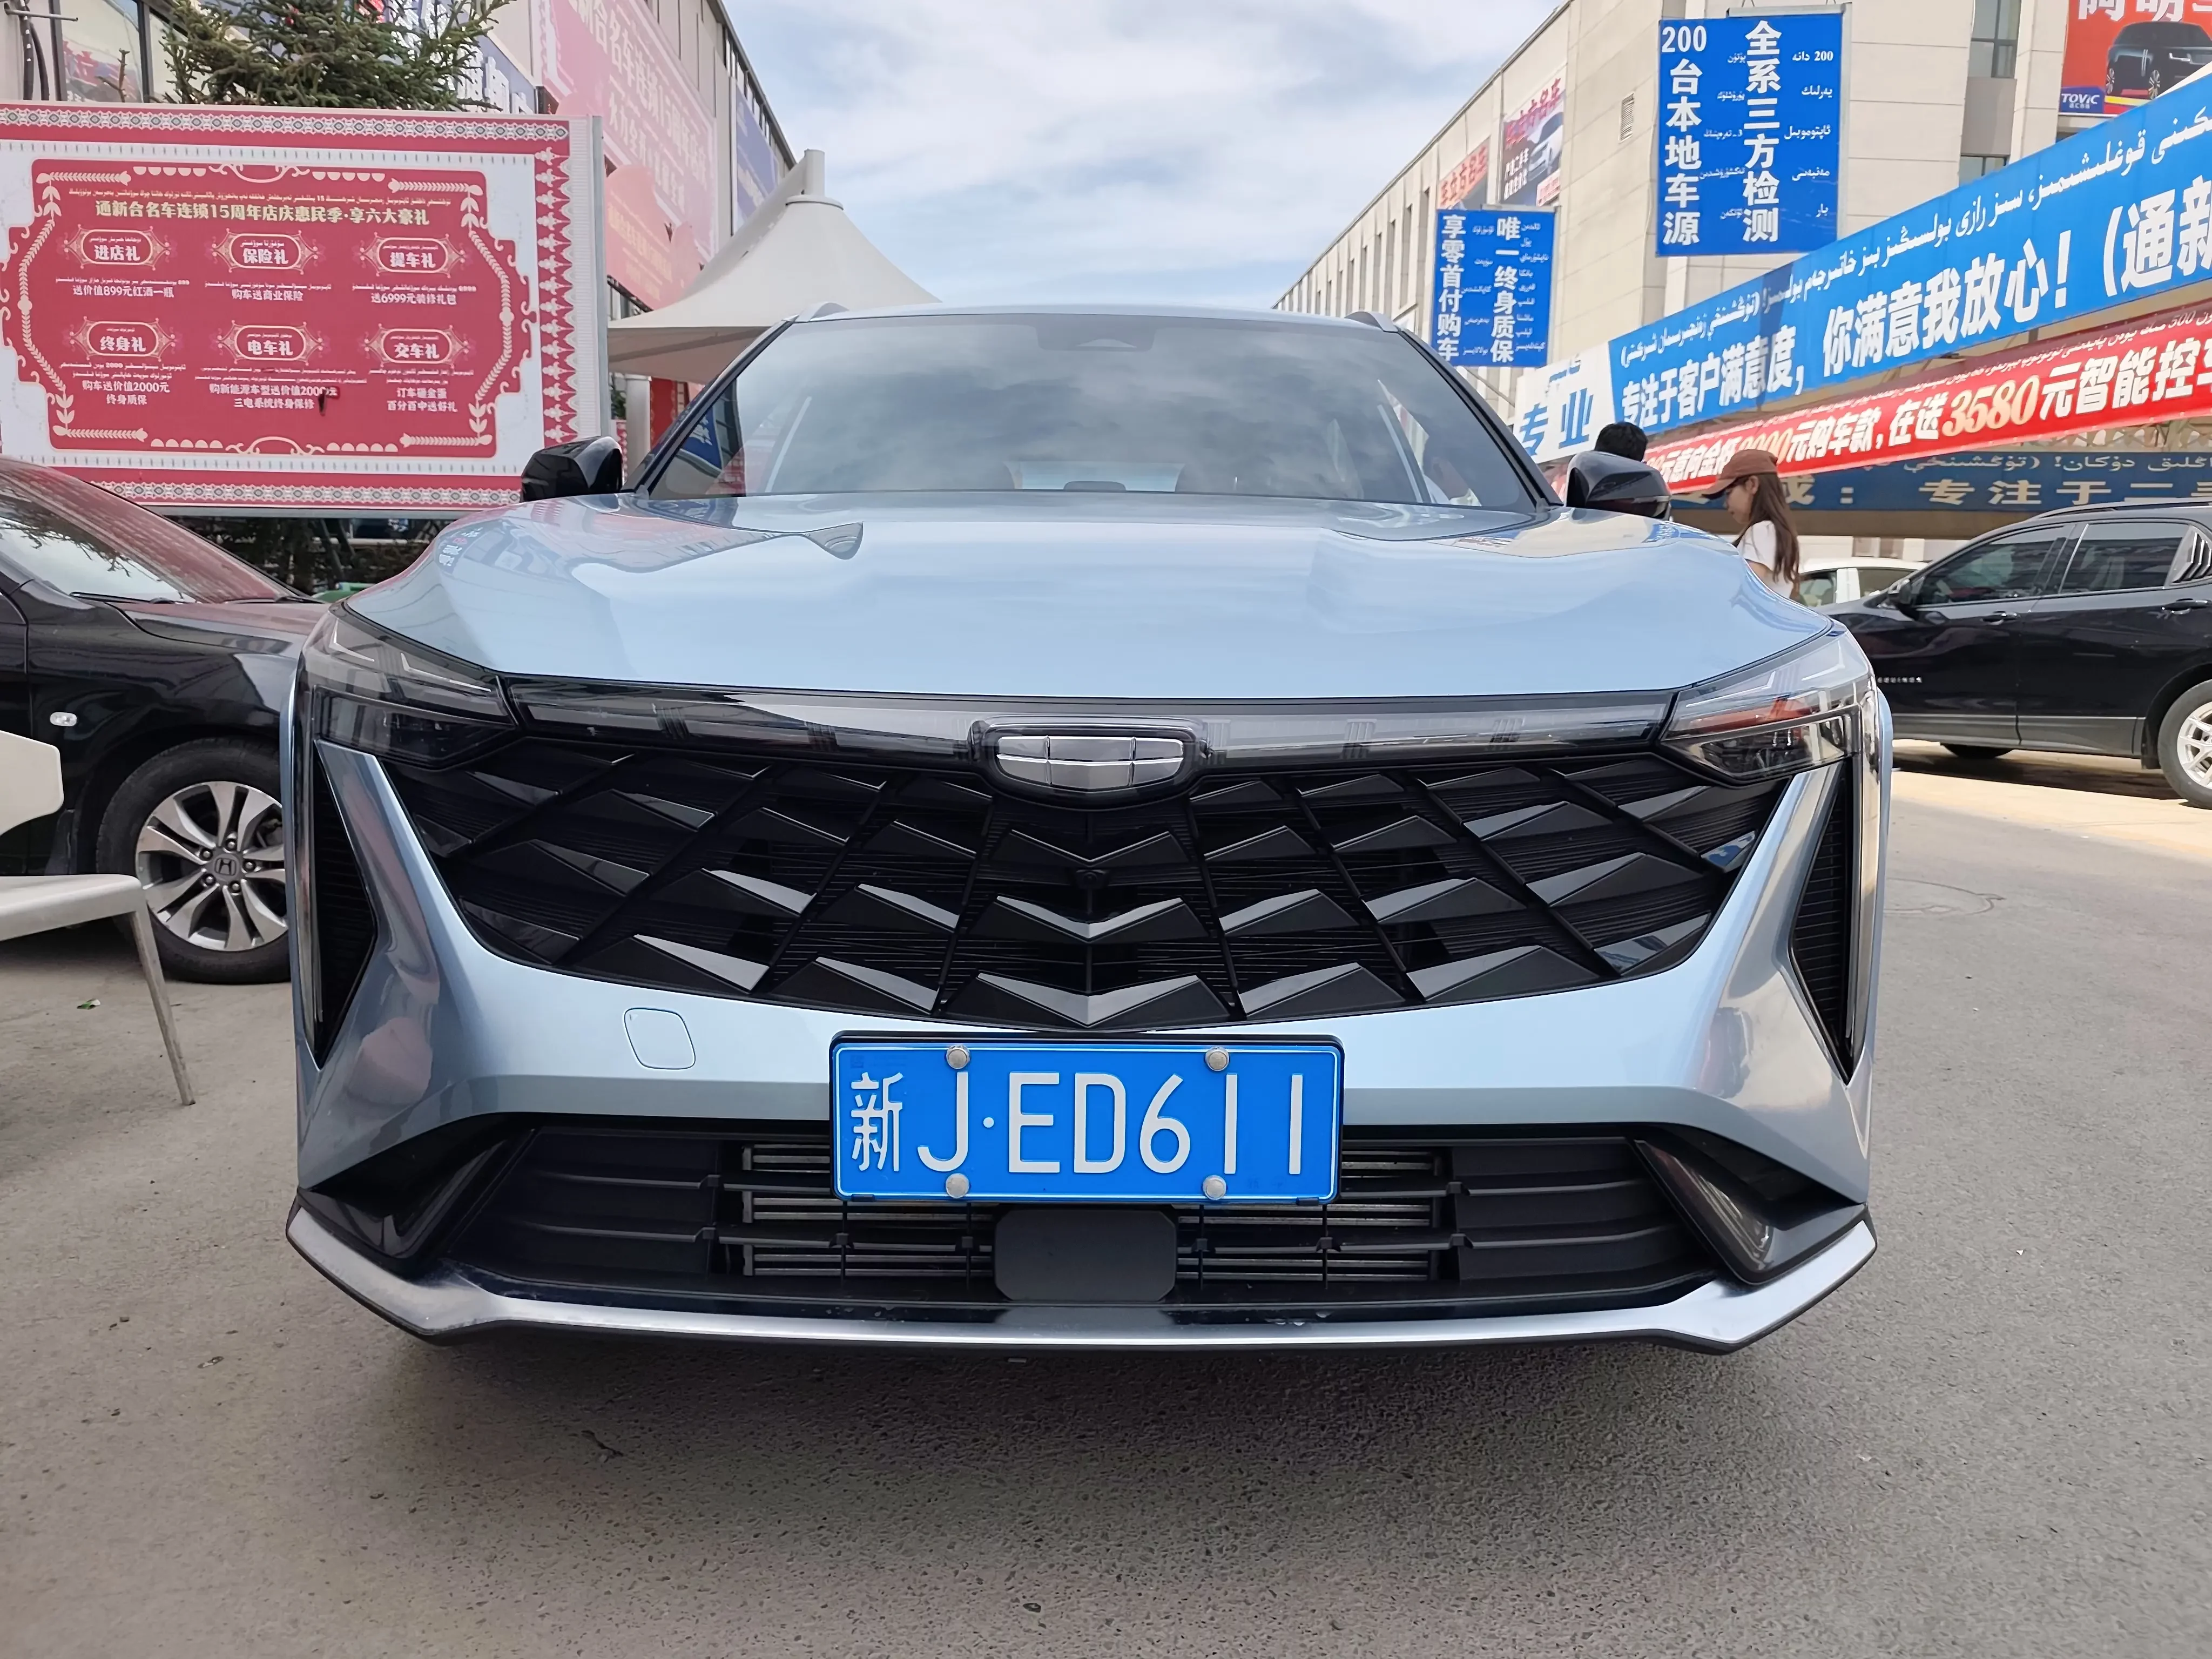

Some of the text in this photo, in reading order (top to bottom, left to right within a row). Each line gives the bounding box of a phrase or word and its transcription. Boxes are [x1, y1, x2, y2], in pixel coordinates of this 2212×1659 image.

[1814, 51, 1833, 62] 200
[2061, 93, 2100, 104] TOVIC
[1662, 25, 1707, 246] 200 台本地车源
[1742, 20, 1782, 242] 全系三方检测
[95, 245, 140, 261] 进店礼
[243, 248, 288, 265] 保险礼
[390, 252, 436, 268] 提车礼
[73, 285, 174, 298] 送价值899元红酒一瓶
[232, 288, 304, 301] 购车送商业保险
[1437, 214, 1466, 361] 享零首付购车
[1491, 216, 1521, 362] 唯一终身质保
[100, 336, 146, 352] 终身礼
[247, 340, 293, 356] 电车礼
[394, 342, 440, 359] 交车礼
[82, 380, 171, 393] 购车送价值2000元
[106, 394, 147, 406] 终身质保
[1516, 387, 1594, 456] 专业
[851, 1071, 1303, 1175] 新J·ED611
